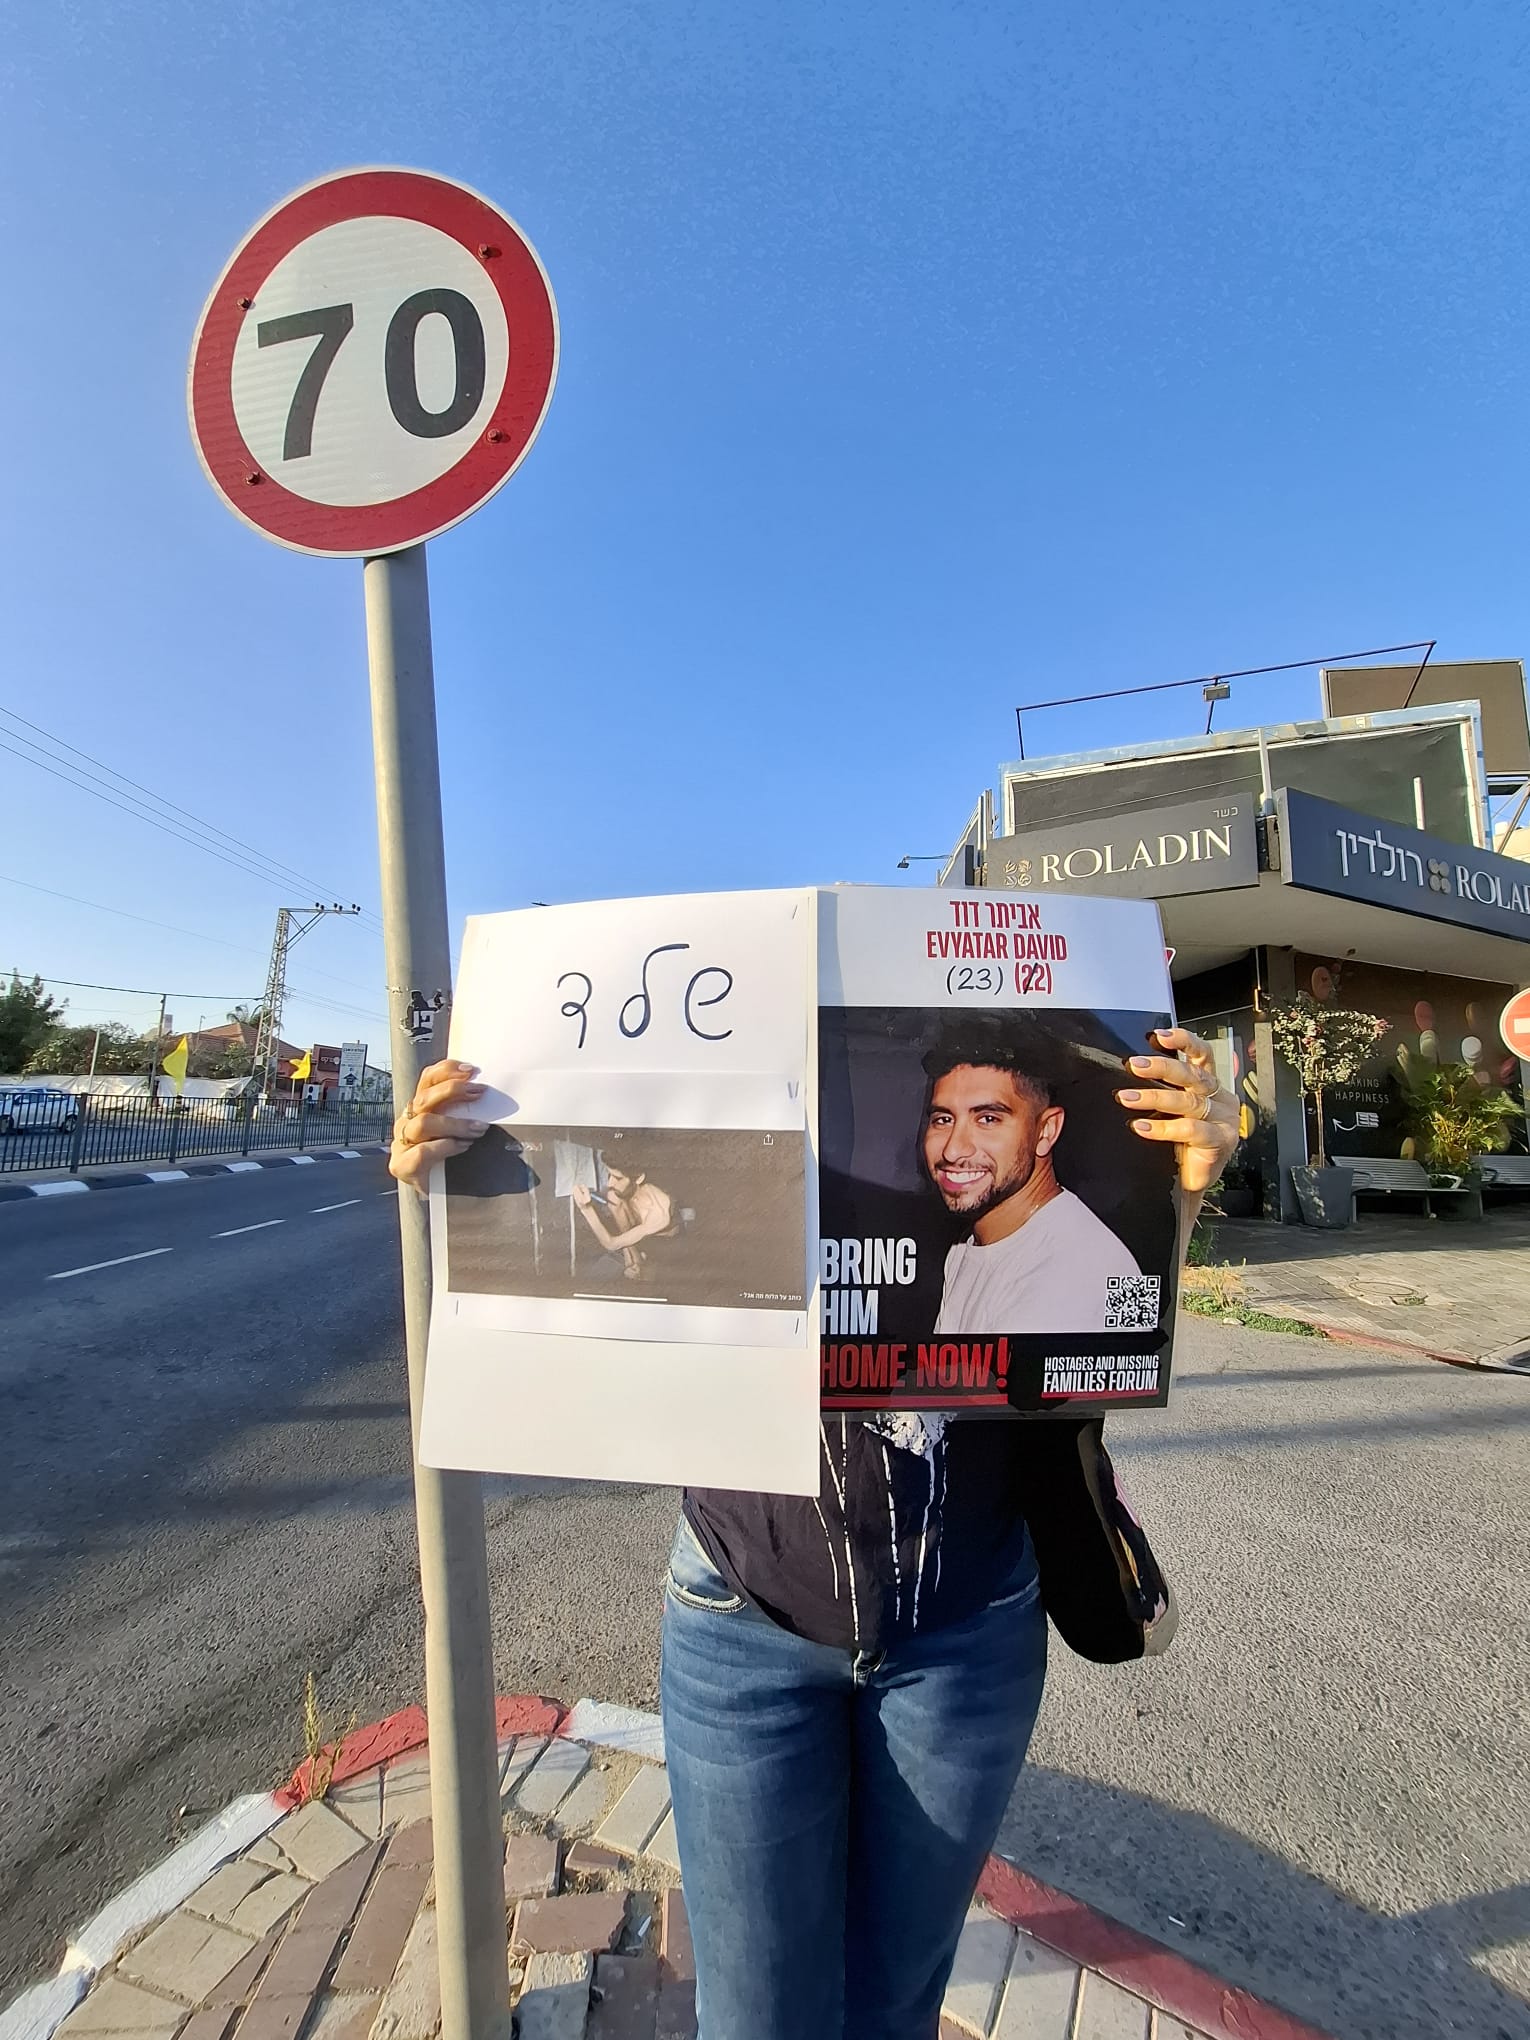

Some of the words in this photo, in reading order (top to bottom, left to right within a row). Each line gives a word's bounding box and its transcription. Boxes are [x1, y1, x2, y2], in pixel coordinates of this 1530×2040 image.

[257, 288, 486, 461] 70
[1212, 807, 1239, 818] כשר
[1041, 825, 1233, 884] ROLADIN
[1336, 829, 1424, 886] רולדין
[950, 901, 980, 927] דוד
[984, 901, 1042, 929] אביתר
[927, 931, 1009, 959] EVYATAR
[1013, 933, 1068, 960] DAVID
[946, 965, 1004, 995] (23)
[1014, 961, 1053, 994] (22)
[1335, 1090, 1389, 1103] HAPPINESS
[1344, 1077, 1380, 1088] AKING
[819, 1237, 917, 1285] BRING
[819, 1289, 879, 1335] HIM
[820, 1343, 907, 1388] HOME
[916, 1337, 1008, 1388] NOW!
[1044, 1356, 1094, 1371] HOSTAGES
[1095, 1355, 1115, 1371] AND
[1116, 1354, 1159, 1370] MISSING
[1043, 1371, 1106, 1393] FAMILIES
[1108, 1369, 1159, 1392] FORUM
